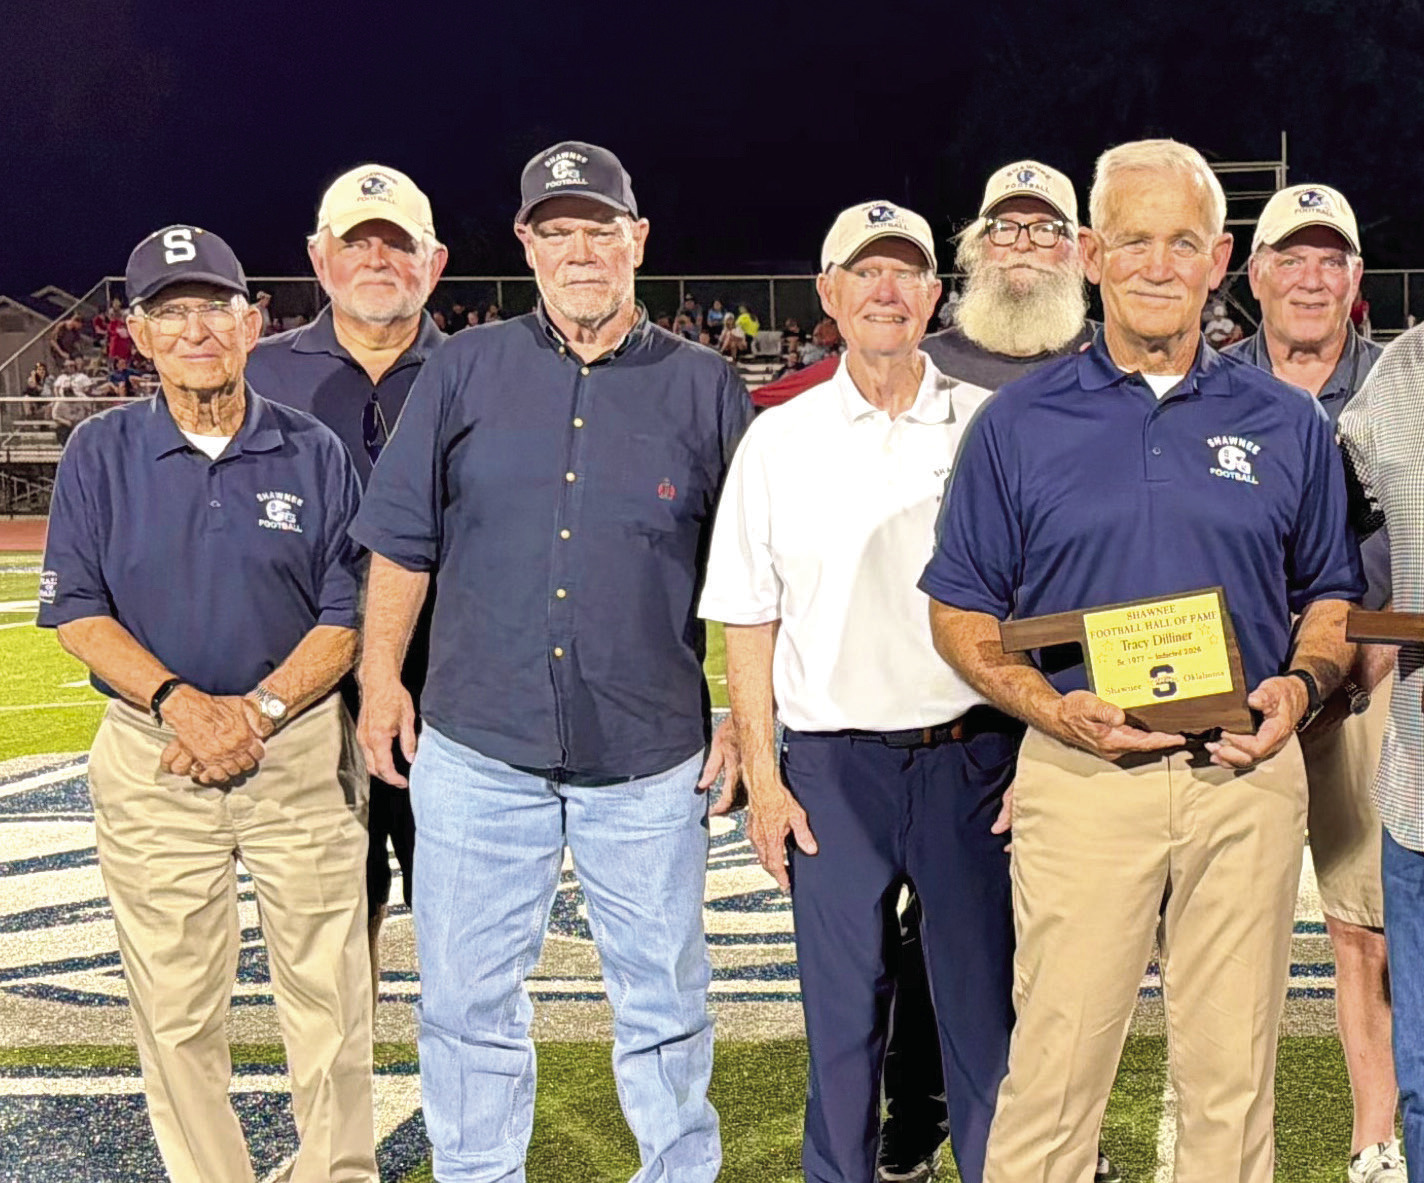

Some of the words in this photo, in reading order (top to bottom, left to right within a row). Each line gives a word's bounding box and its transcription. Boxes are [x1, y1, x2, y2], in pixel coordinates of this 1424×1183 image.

[544, 152, 588, 168] SHAWNEE
[545, 178, 589, 189] FOOTBALL
[1005, 183, 1050, 194] FOOTBALL
[357, 196, 398, 205] FOOTBALL
[1294, 208, 1335, 219] FOOTBALL
[162, 227, 196, 264] S
[1206, 434, 1261, 455] SHAWNEE
[1209, 467, 1259, 485] FOOTBALL
[256, 491, 304, 507] SHAWNEE
[258, 519, 303, 533] FOOTBALL
[1127, 605, 1176, 620] SHAWNEE
[1090, 625, 1141, 639] FOOTBALL
[1145, 620, 1171, 632] HALL
[1174, 617, 1187, 625] OF
[1190, 611, 1216, 623] FAME
[1121, 639, 1149, 651] Tracy
[1153, 631, 1192, 645] Dilliner
[1183, 670, 1224, 681] Oklahoma
[1105, 684, 1141, 695] Shawnee
